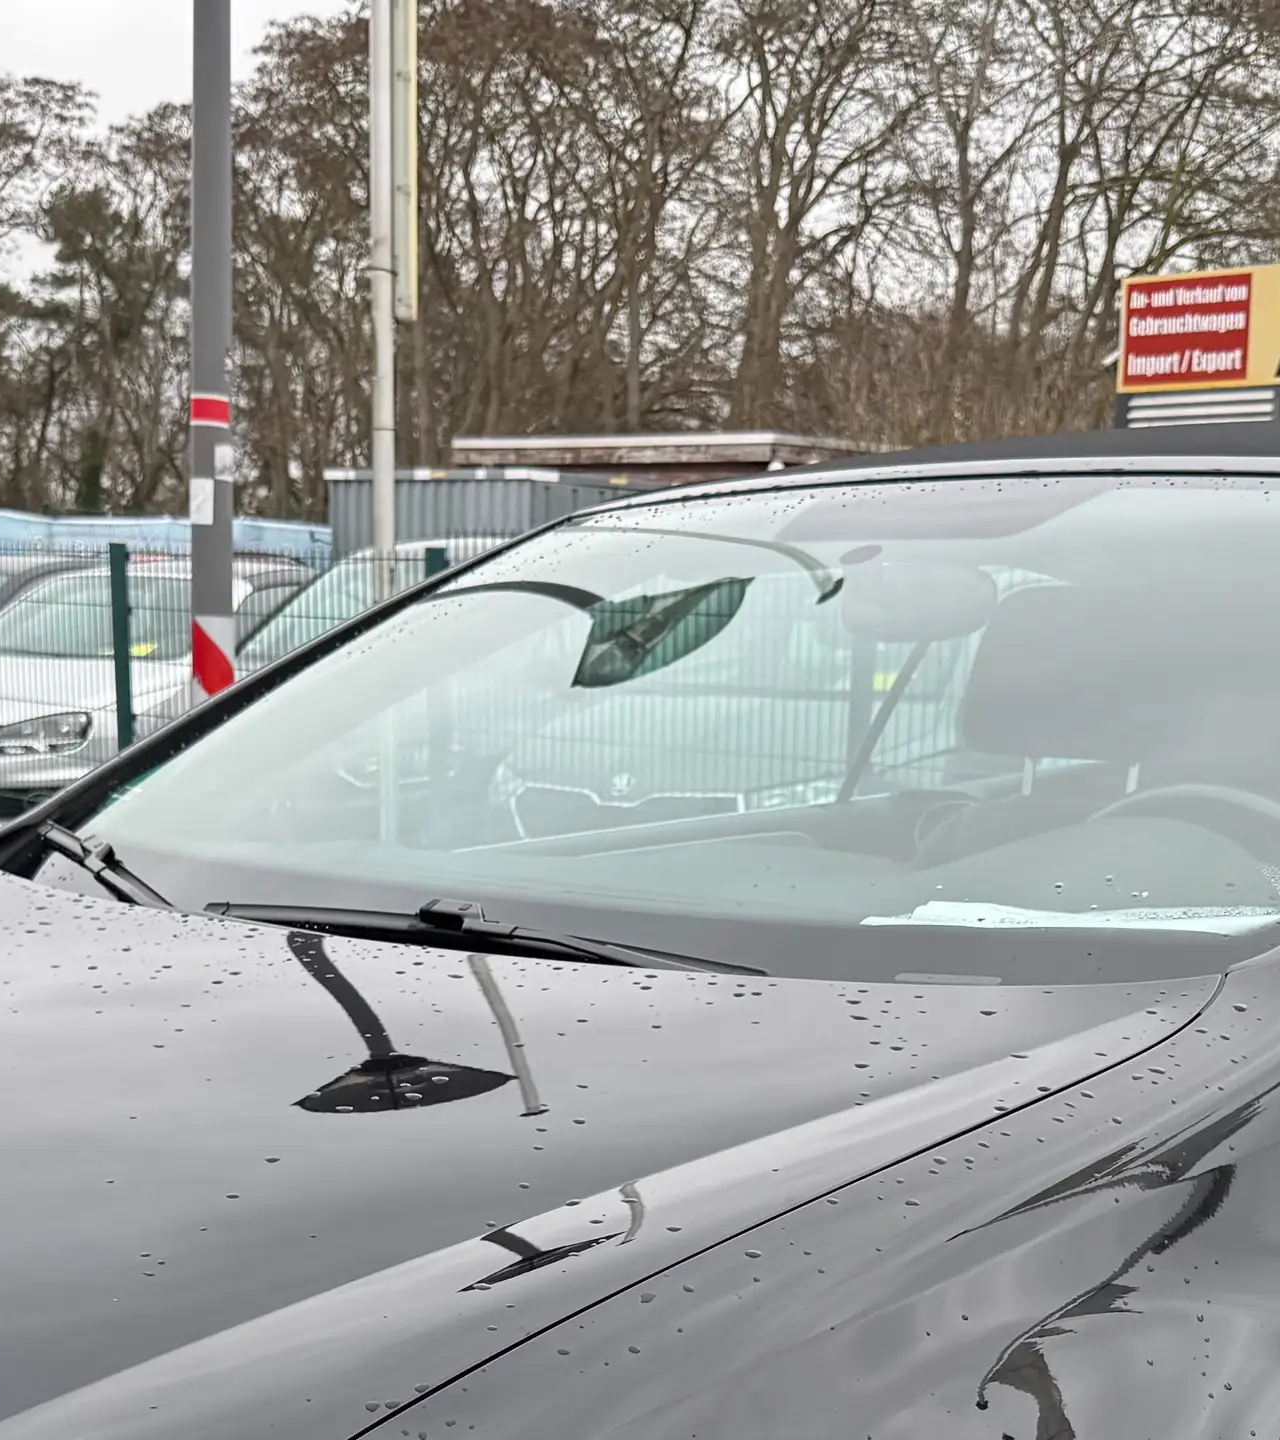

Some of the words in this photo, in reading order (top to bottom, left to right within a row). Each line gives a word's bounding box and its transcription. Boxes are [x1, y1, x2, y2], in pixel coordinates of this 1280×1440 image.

[1151, 287, 1175, 308] und
[1175, 285, 1224, 306] Verkauf
[1224, 284, 1249, 302] von
[1129, 312, 1247, 337] Gebrauchtwagen
[1127, 350, 1180, 377] Import
[1191, 347, 1243, 374] Export
